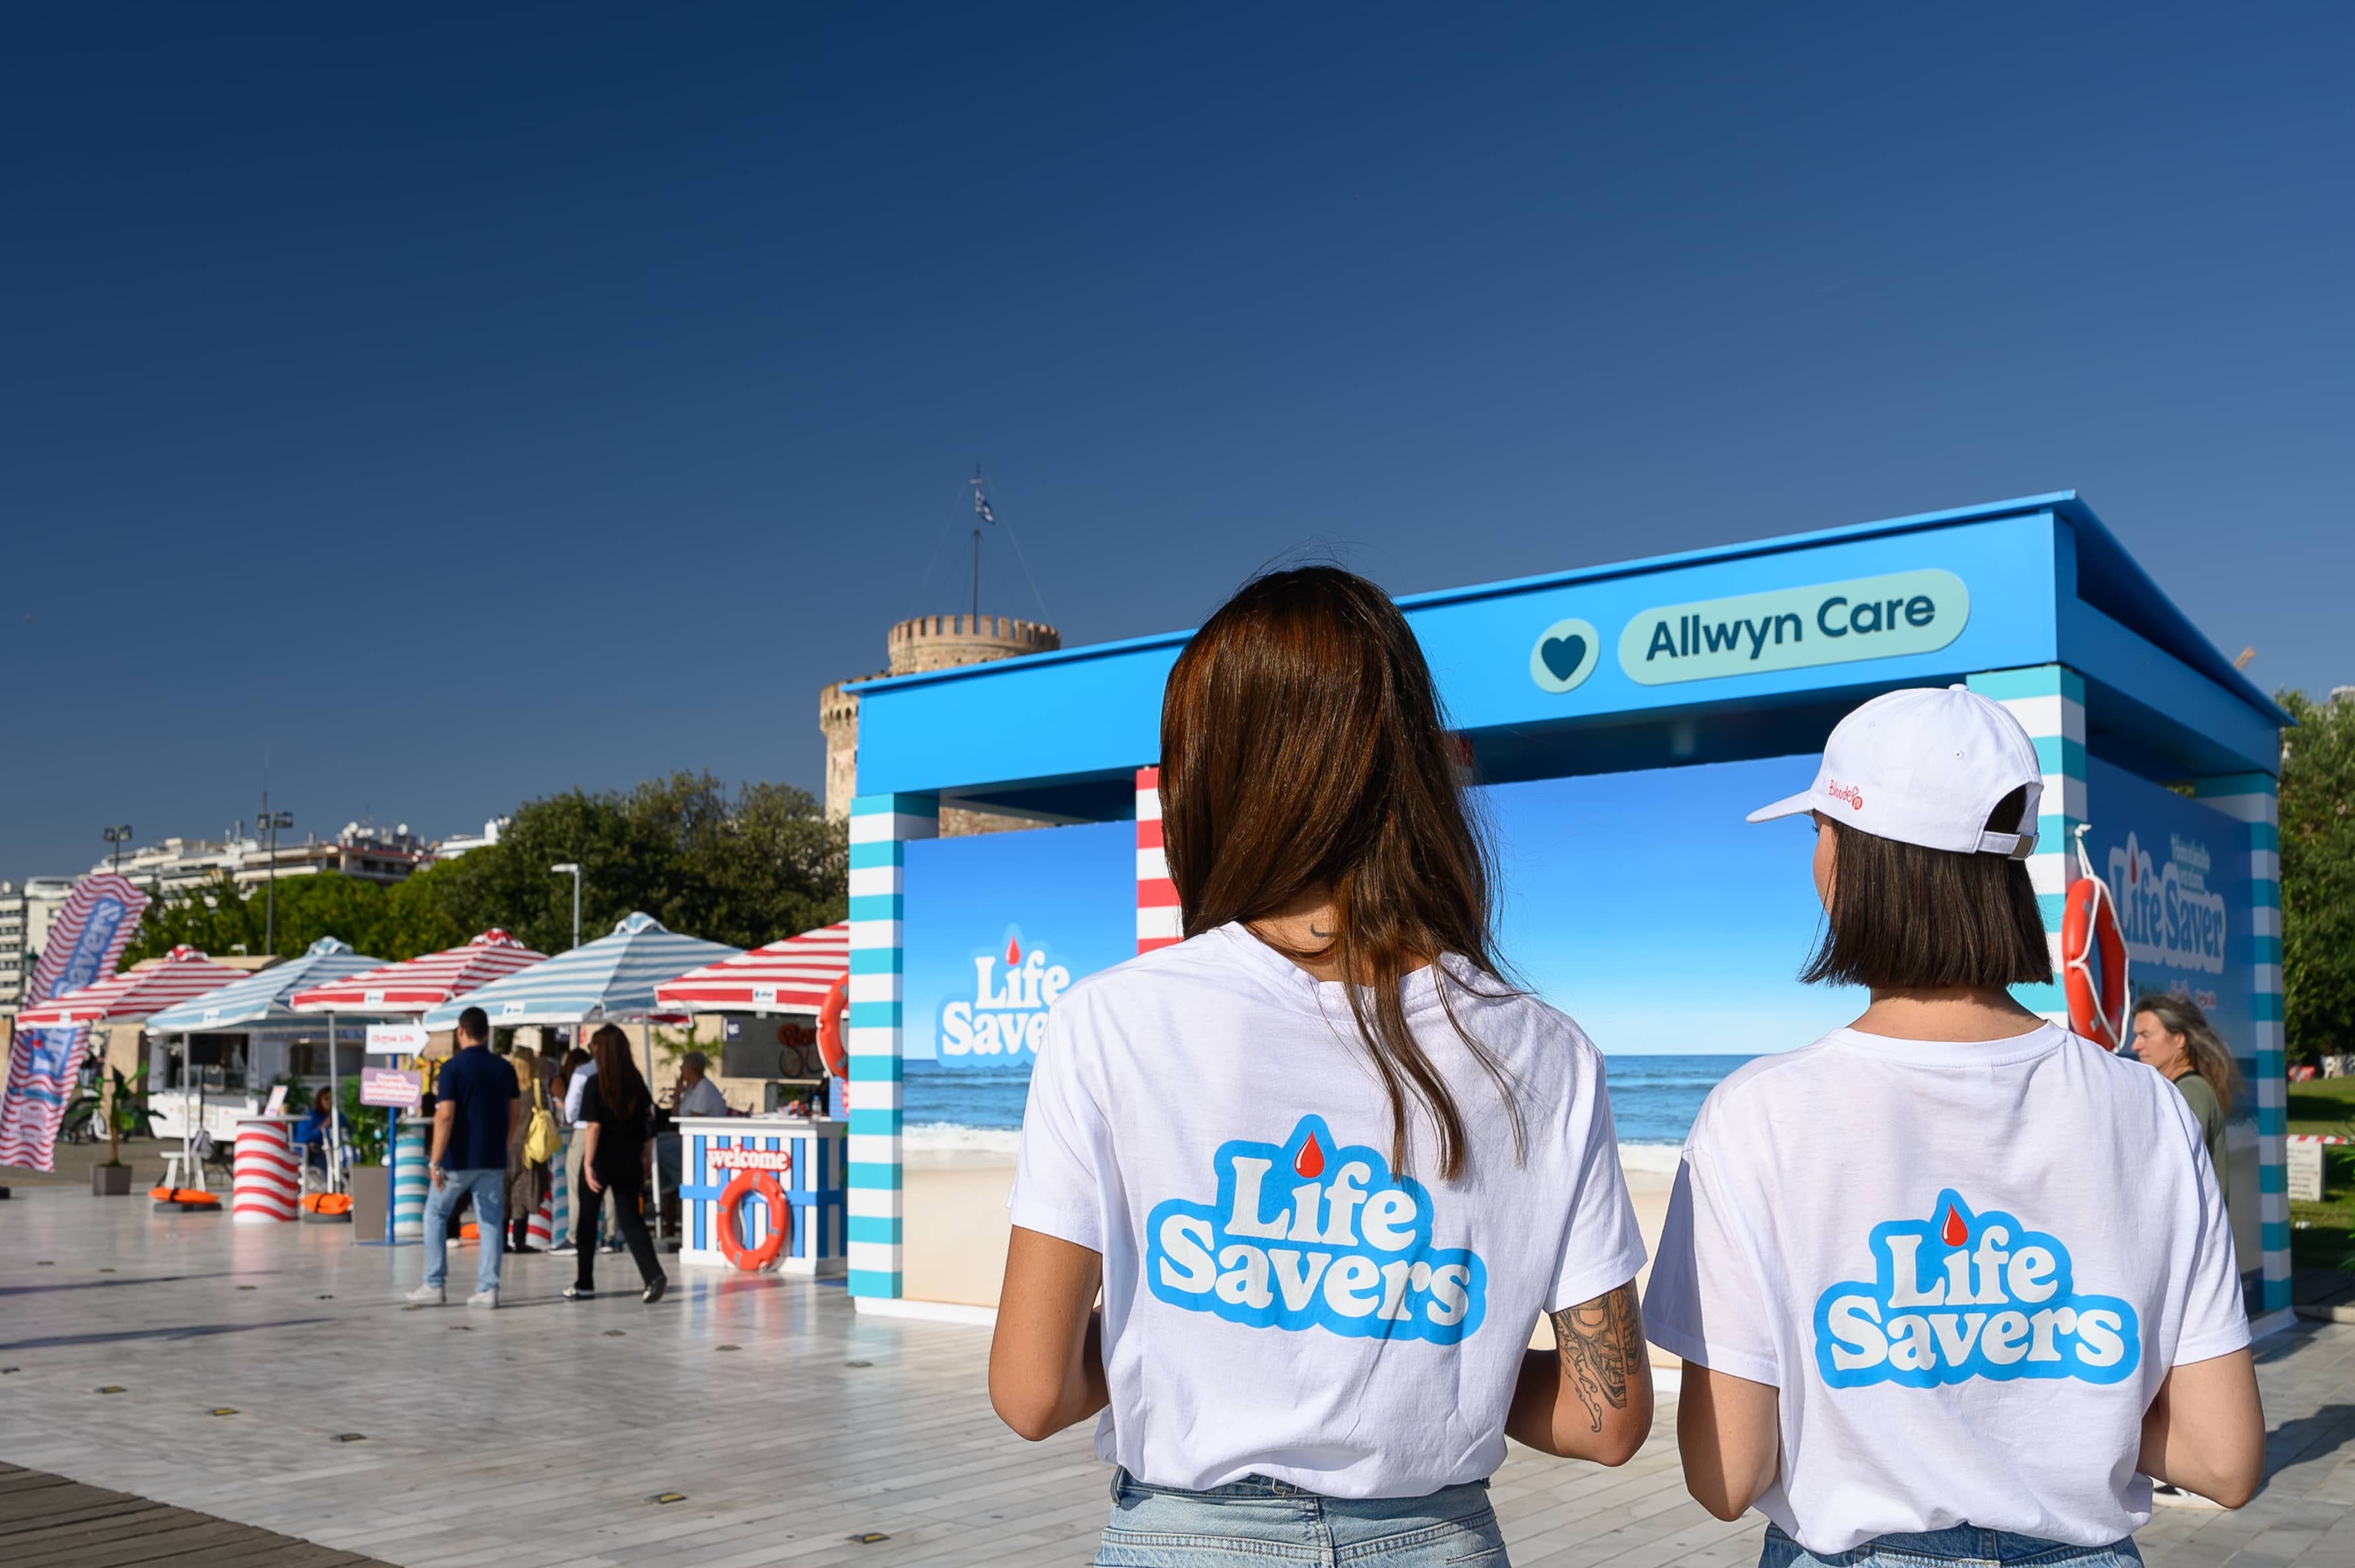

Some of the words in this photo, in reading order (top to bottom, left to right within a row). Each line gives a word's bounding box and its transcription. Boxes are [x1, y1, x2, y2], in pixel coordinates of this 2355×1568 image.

[1646, 613, 1802, 661] Allwyn
[1817, 595, 1936, 638] Care
[2113, 848, 2162, 949] Life
[2165, 878, 2222, 959] Saver
[974, 935, 1070, 1010] Life
[942, 1001, 1049, 1056] Save
[706, 1145, 789, 1172] welcome
[1224, 1130, 1417, 1251] Life
[1159, 1213, 1471, 1326] Savers
[1885, 1202, 2058, 1307] Life
[1827, 1295, 2125, 1371] Savers
